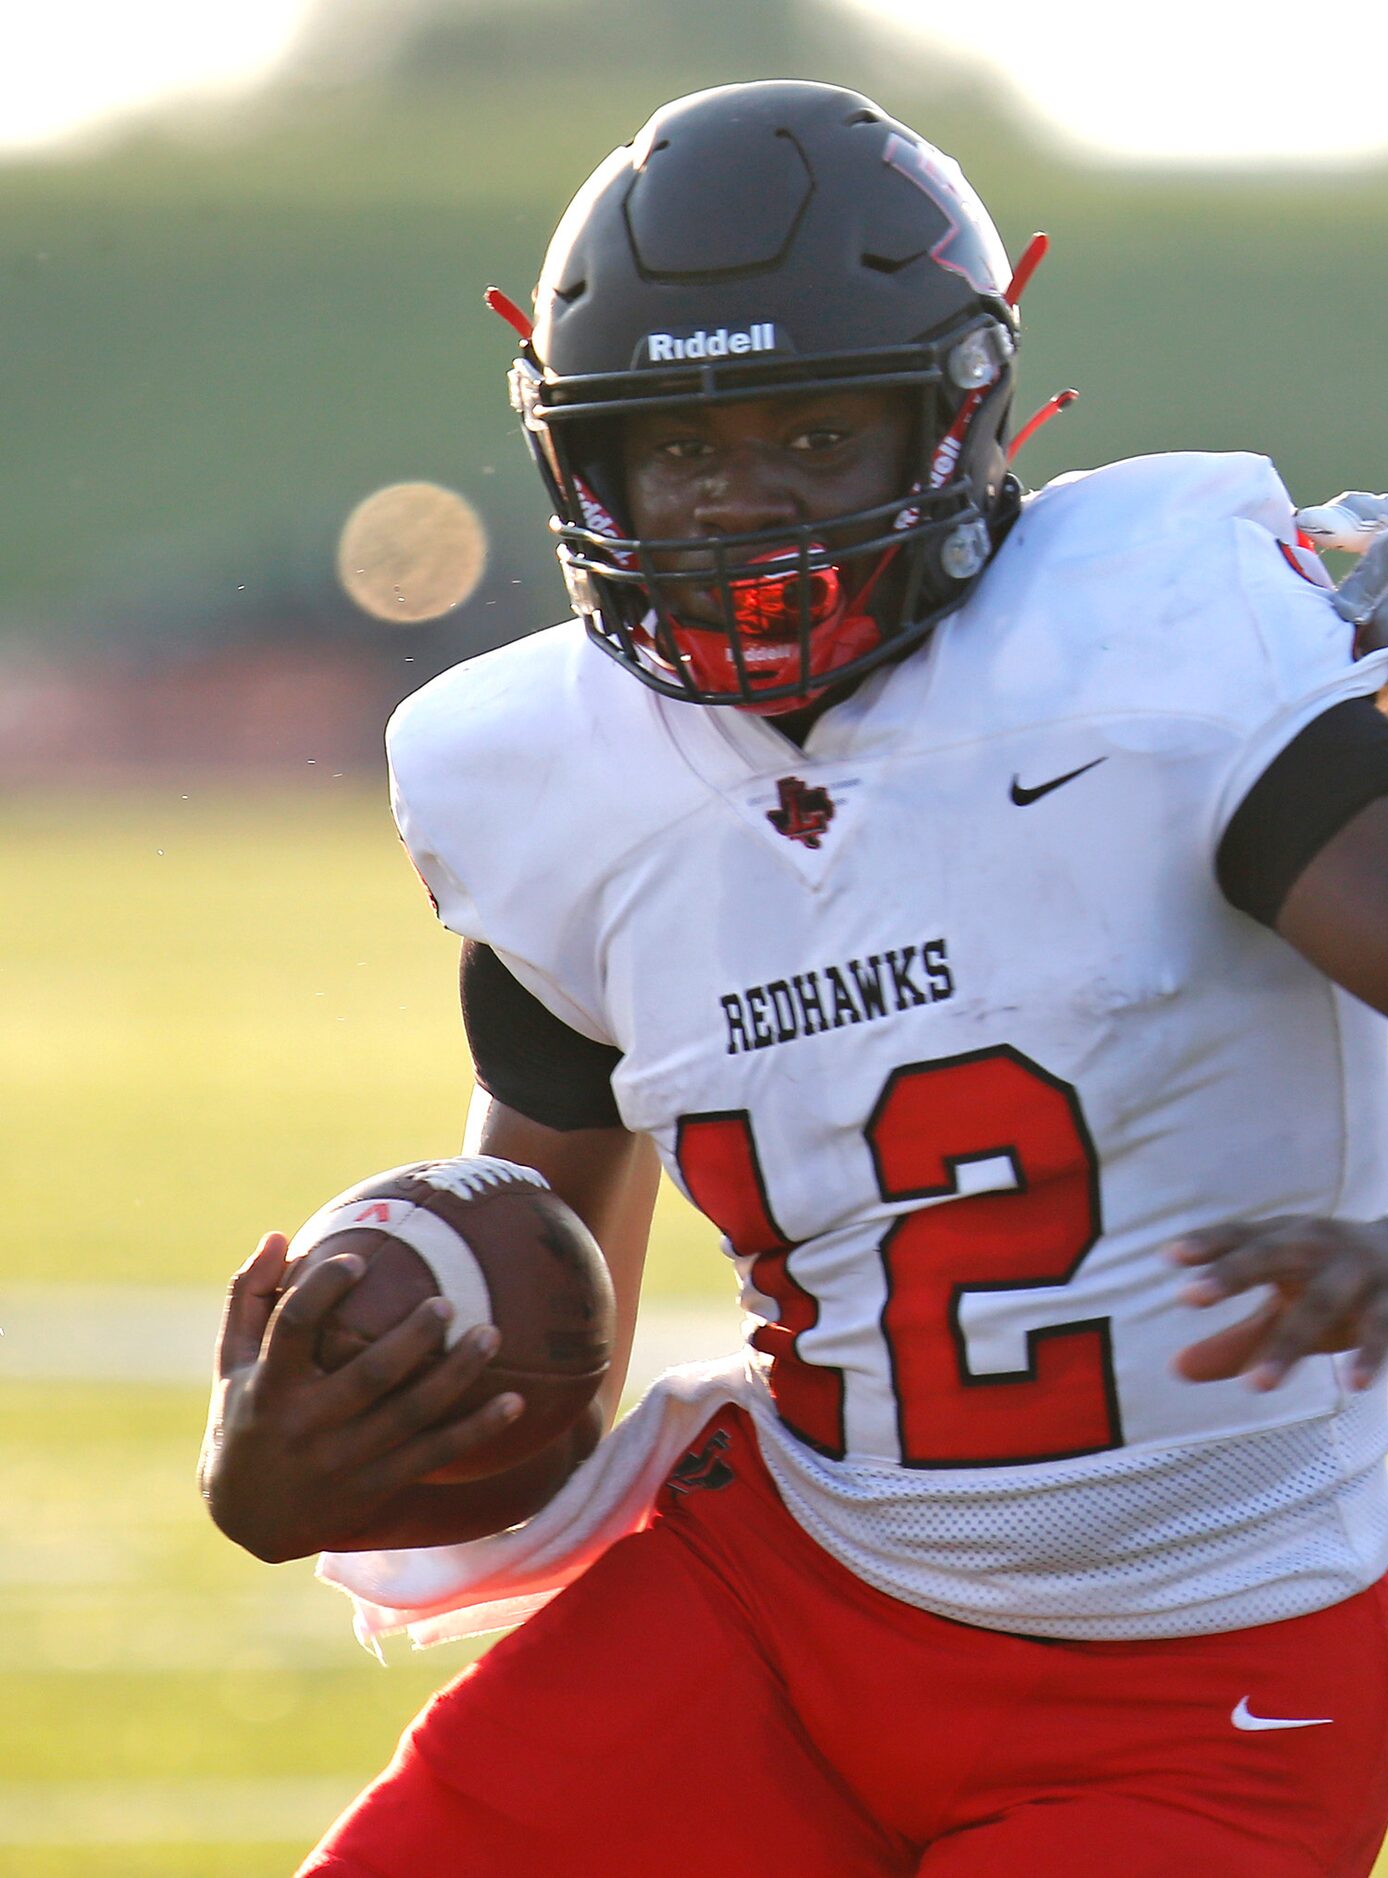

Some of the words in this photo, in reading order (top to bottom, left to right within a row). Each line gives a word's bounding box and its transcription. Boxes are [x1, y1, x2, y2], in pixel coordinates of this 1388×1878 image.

[648, 322, 775, 361] Riddell
[720, 938, 954, 1054] REDHAWKS
[675, 1043, 1125, 1469] 12
